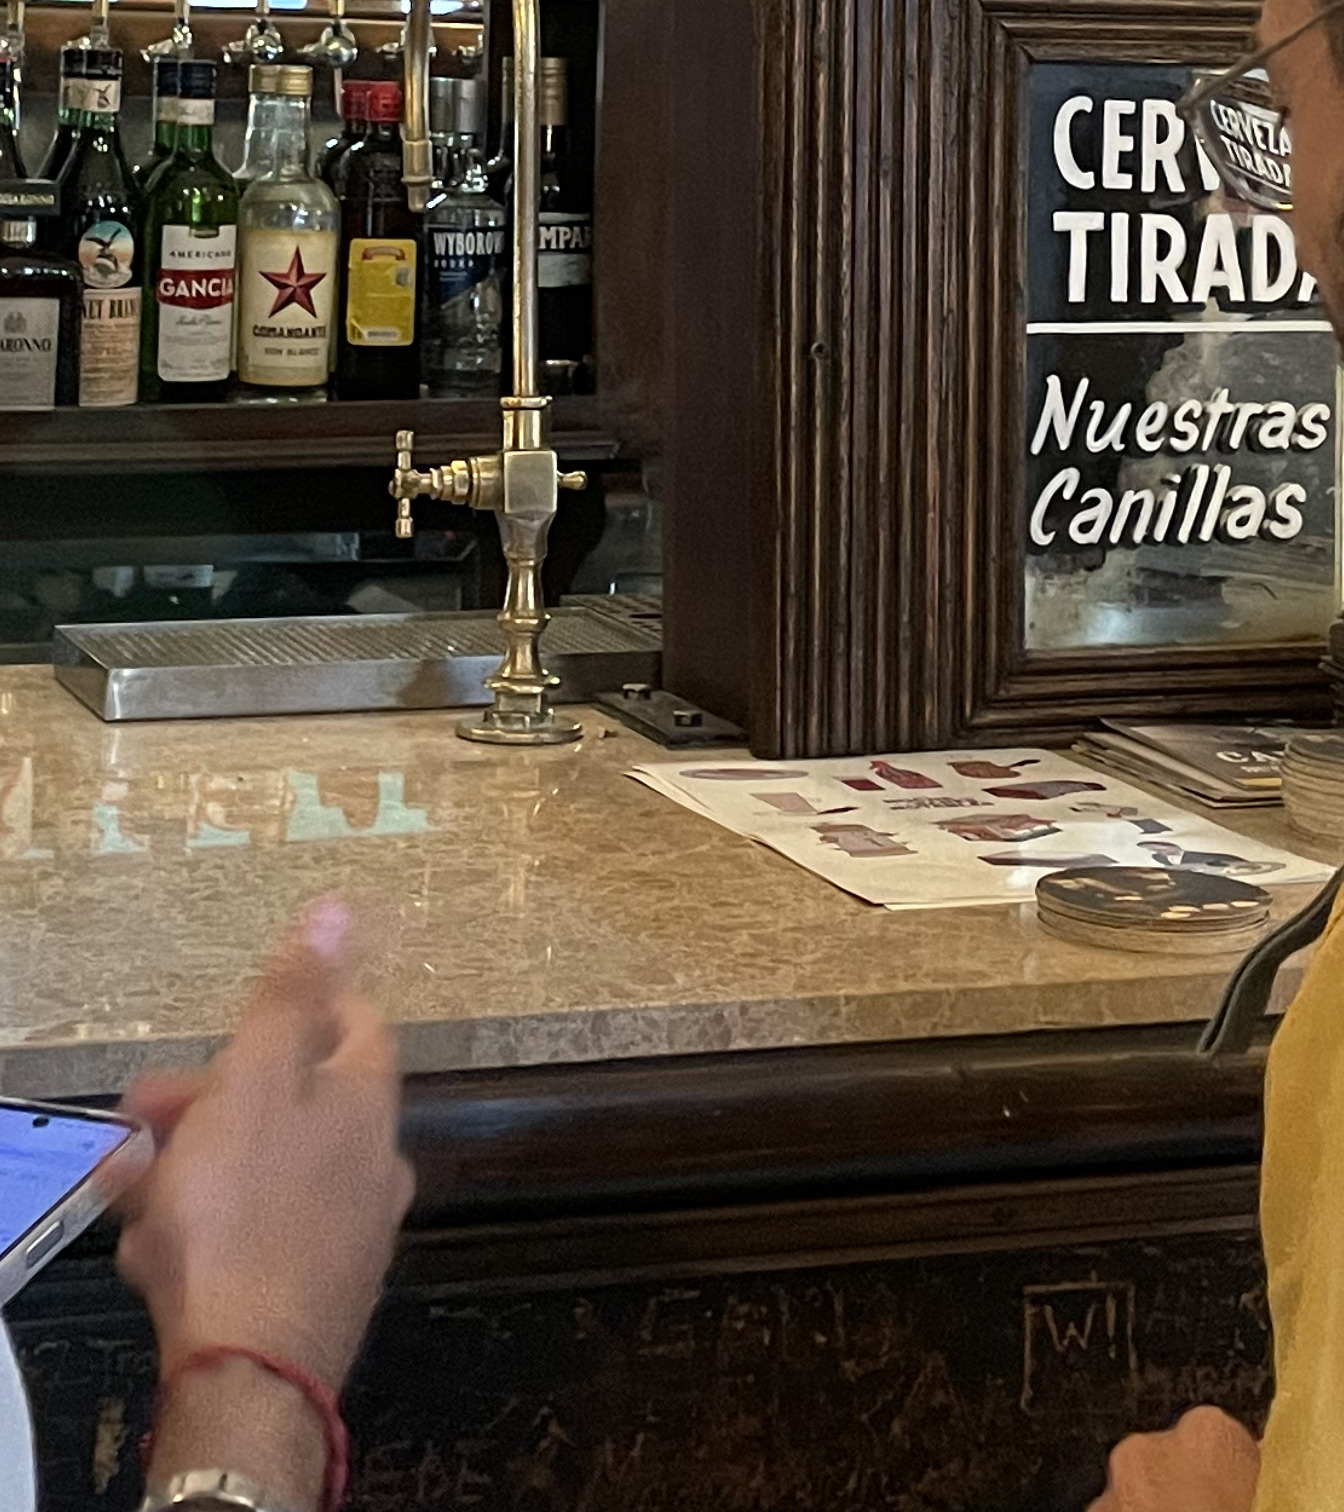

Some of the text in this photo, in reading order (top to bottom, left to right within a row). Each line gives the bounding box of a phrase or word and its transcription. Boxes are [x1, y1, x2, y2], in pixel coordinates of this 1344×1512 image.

[169, 250, 232, 259] AMERICANO
[1029, 374, 1331, 456] Nuestras
[1028, 463, 1307, 547] Canillas
